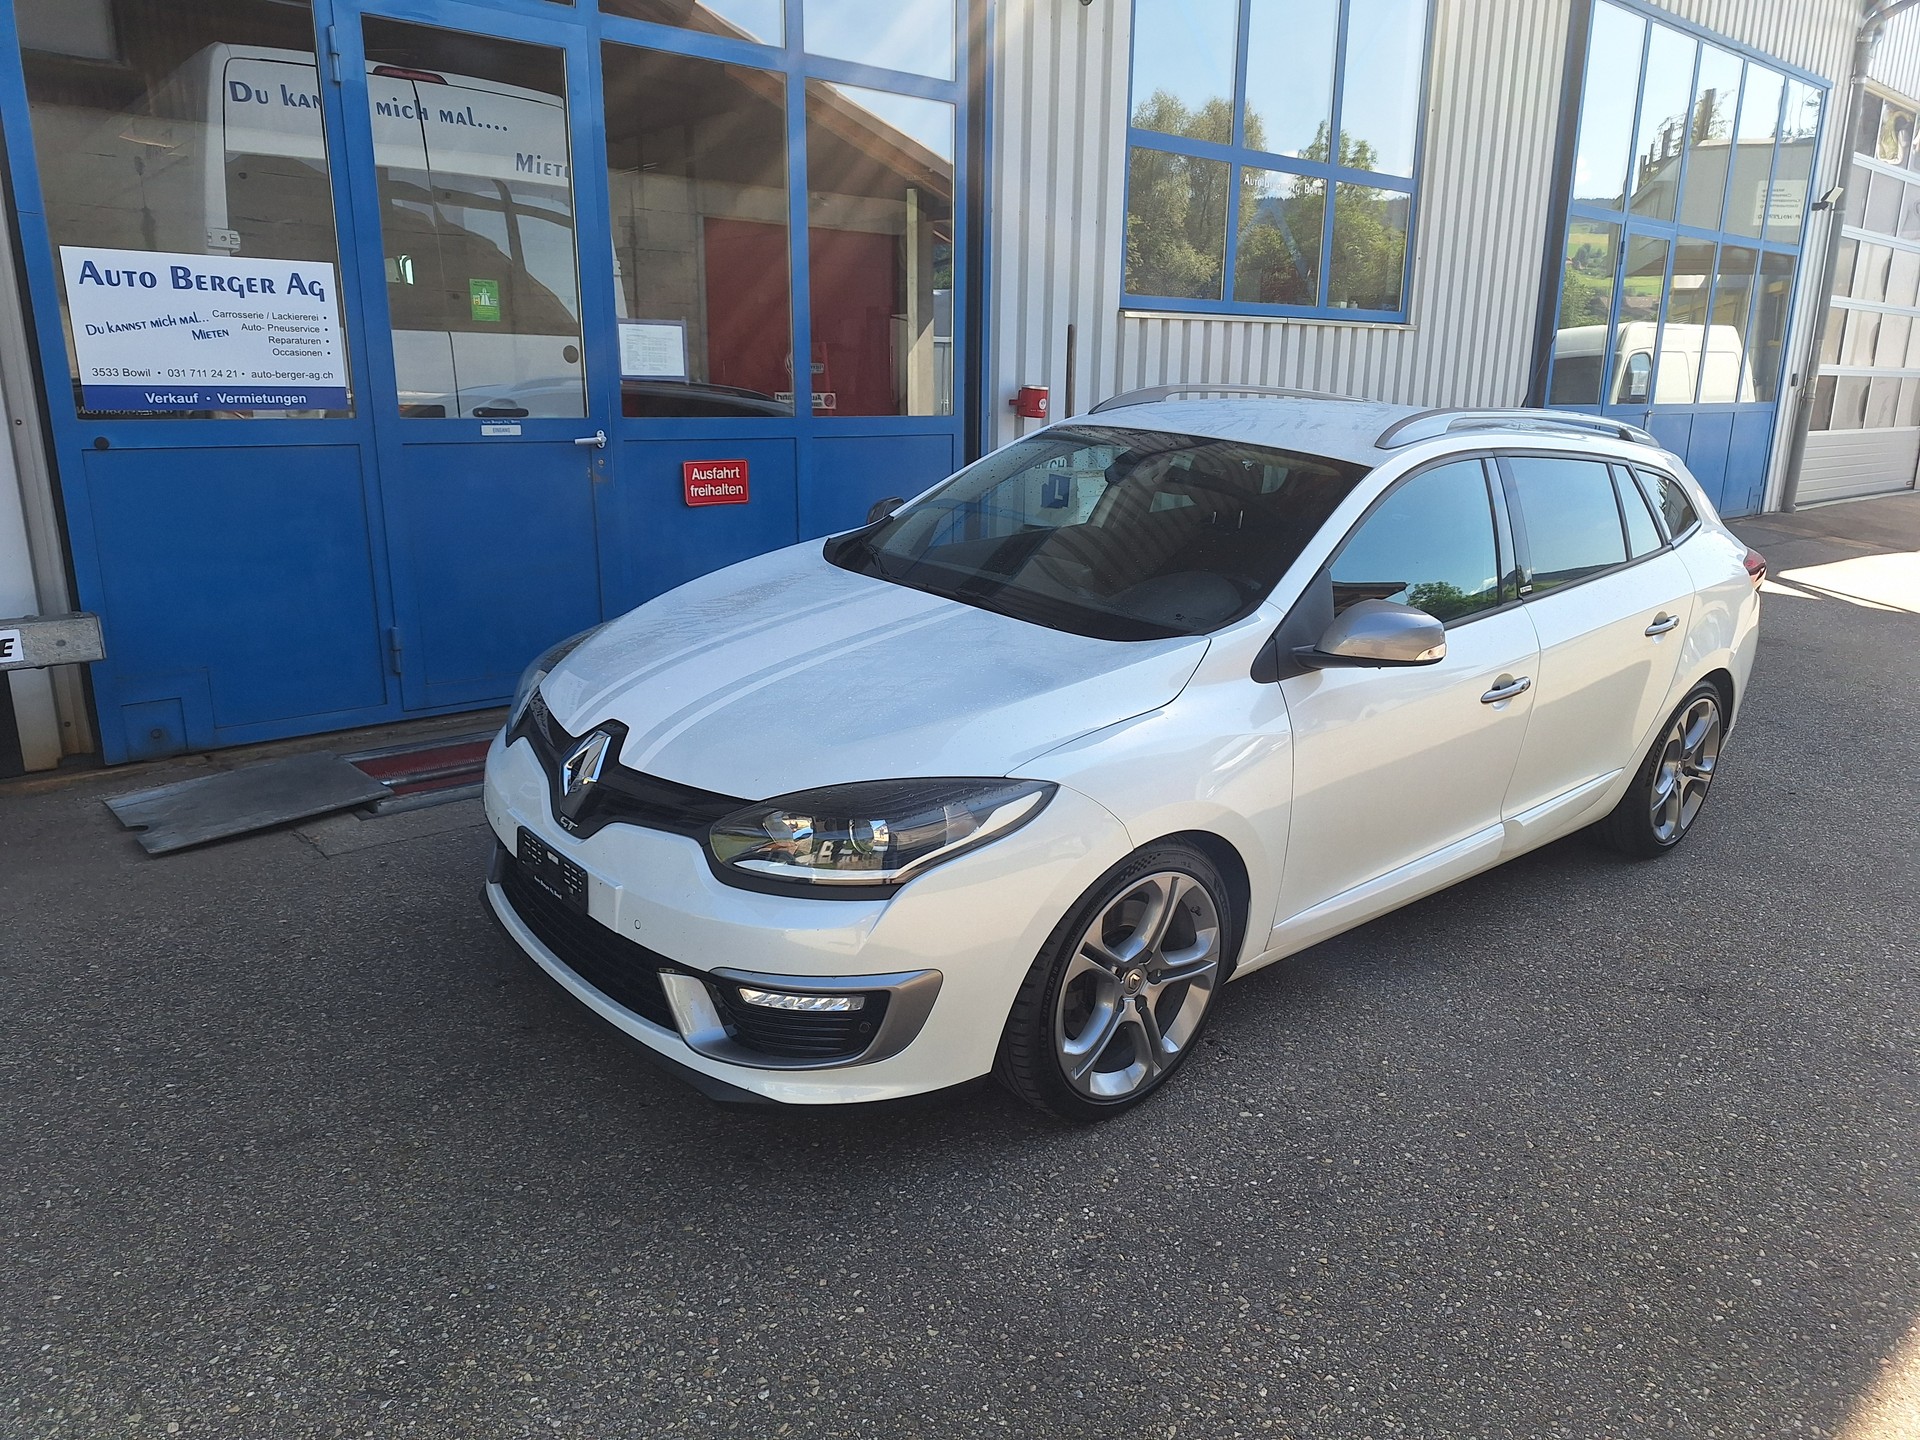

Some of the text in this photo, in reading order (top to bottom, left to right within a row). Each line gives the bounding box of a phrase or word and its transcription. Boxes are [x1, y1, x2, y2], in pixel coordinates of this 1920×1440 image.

[229, 81, 268, 104] Du
[376, 97, 429, 121] mich
[212, 309, 264, 320] Carrosserie
[271, 311, 319, 322] Lackiererei
[85, 323, 105, 336] Du
[150, 314, 177, 328] mich
[241, 322, 320, 333] Auto- Pneuservice
[191, 328, 230, 341] Mieten
[268, 335, 321, 346] Reparaturen
[272, 348, 323, 357] Occasionen
[91, 367, 334, 381] 3533 Bowil 031 711 24 21 auto-berger-ag.ch
[144, 392, 307, 406] Verkauf Vermietungen
[691, 466, 741, 480] Ausfahrt
[690, 483, 744, 498] freihalten
[560, 816, 578, 831] GT
